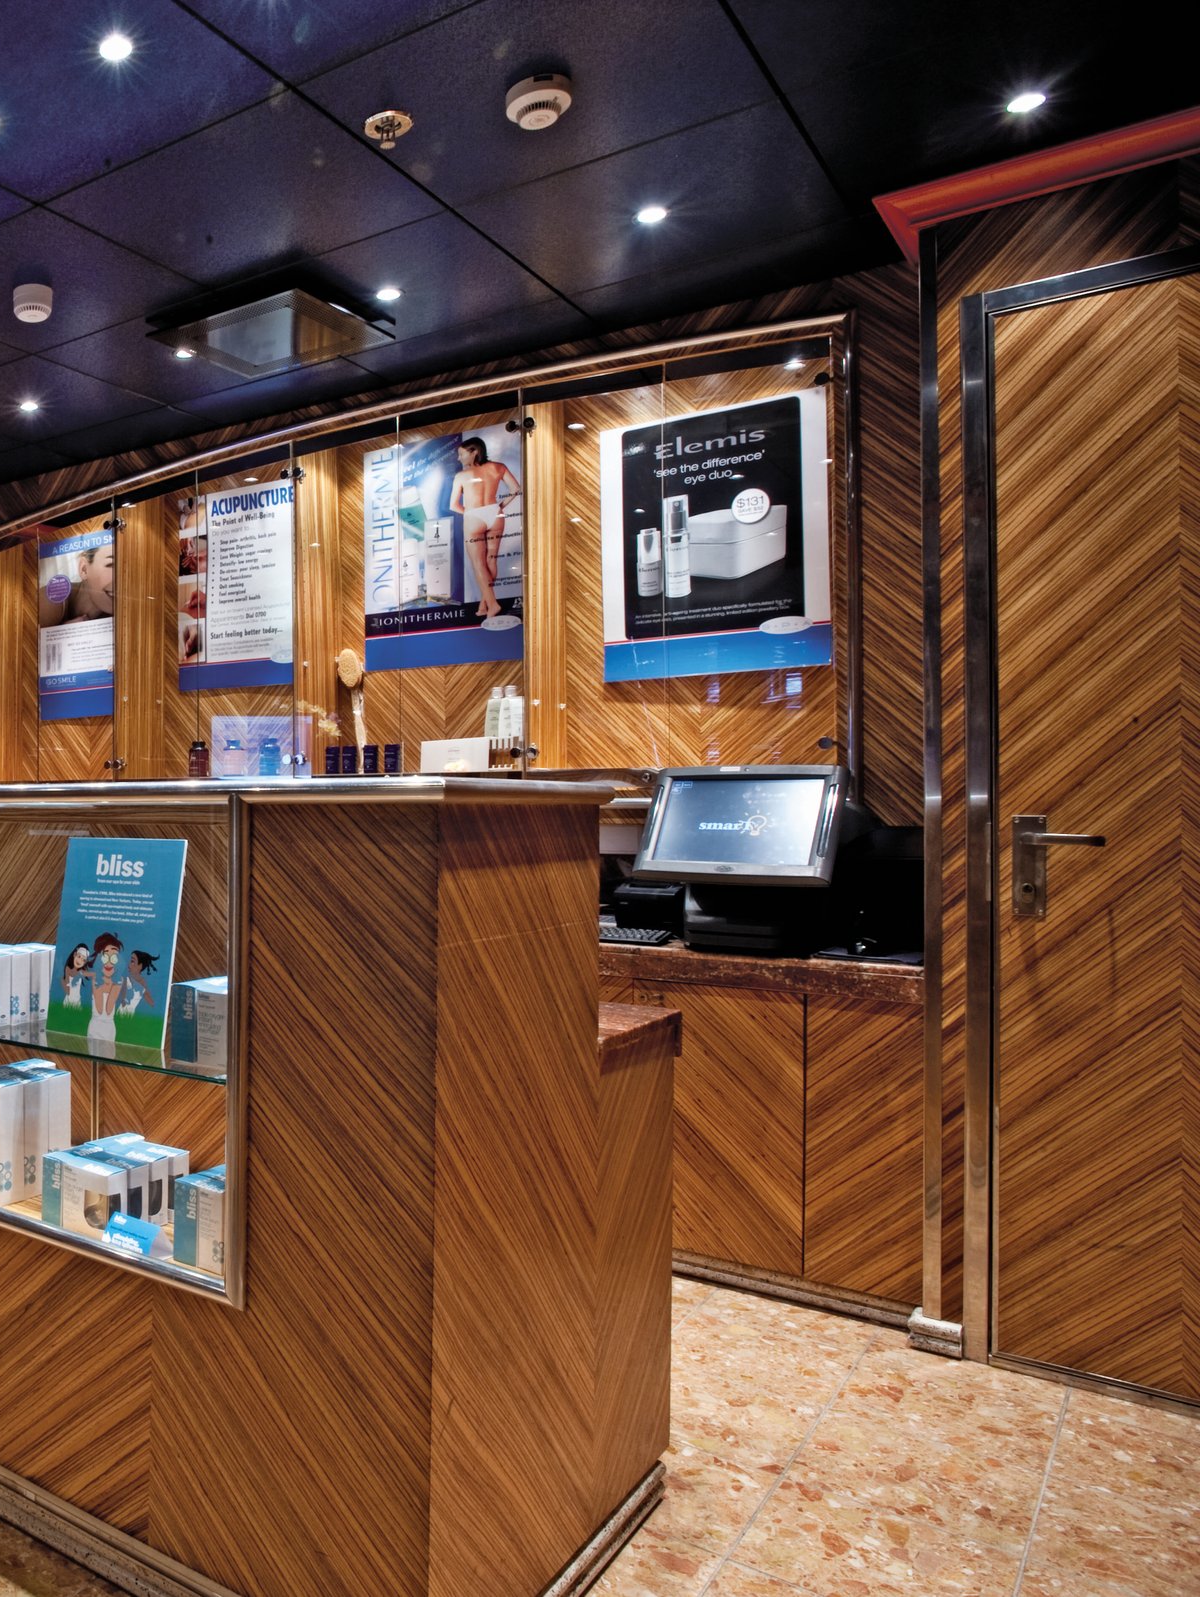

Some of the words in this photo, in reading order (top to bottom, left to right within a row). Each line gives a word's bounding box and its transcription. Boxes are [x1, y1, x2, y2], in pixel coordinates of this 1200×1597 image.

[654, 429, 765, 460] Elemis
[679, 463, 699, 474] the
[683, 473, 706, 485] eye
[708, 469, 733, 480] duo
[211, 486, 294, 517] ACUPUNCTURE
[736, 495, 764, 509] $131
[223, 518, 236, 526] Point
[245, 512, 275, 522] Well-Being
[59, 539, 90, 553] REASON
[91, 536, 102, 546] TO
[379, 609, 465, 626] IONITHERMIE
[210, 631, 224, 640] Start
[225, 629, 243, 638] feeling
[244, 628, 261, 636] better
[96, 853, 145, 878] bliss
[183, 988, 193, 1019] bliss
[52, 1162, 60, 1189] bliss
[186, 1189, 197, 1220] bliss
